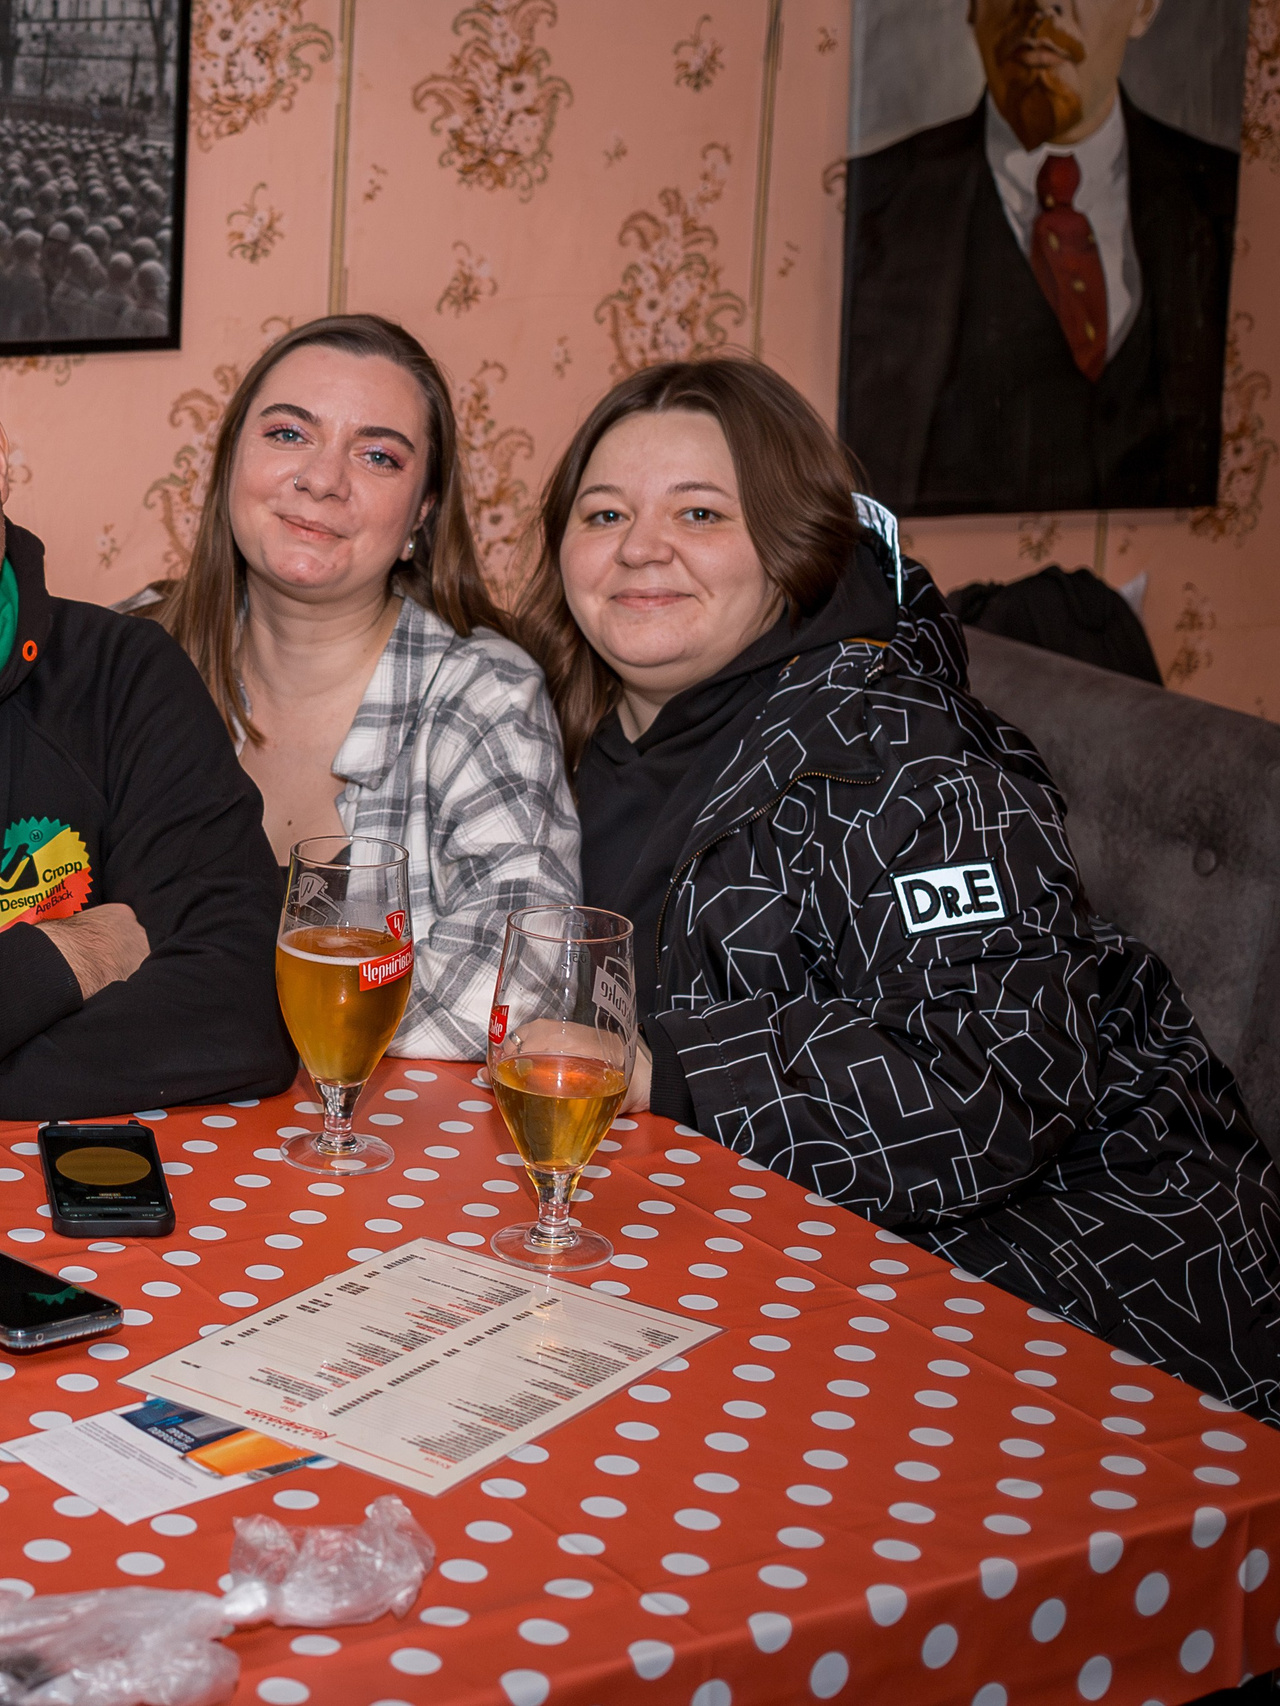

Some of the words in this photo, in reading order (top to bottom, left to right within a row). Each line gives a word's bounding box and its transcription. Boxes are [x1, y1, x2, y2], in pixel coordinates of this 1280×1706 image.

[42, 860, 83, 884] Cropp
[0, 891, 45, 913] Design
[45, 878, 67, 899] unit
[35, 897, 52, 916] Are
[51, 889, 74, 906] Back
